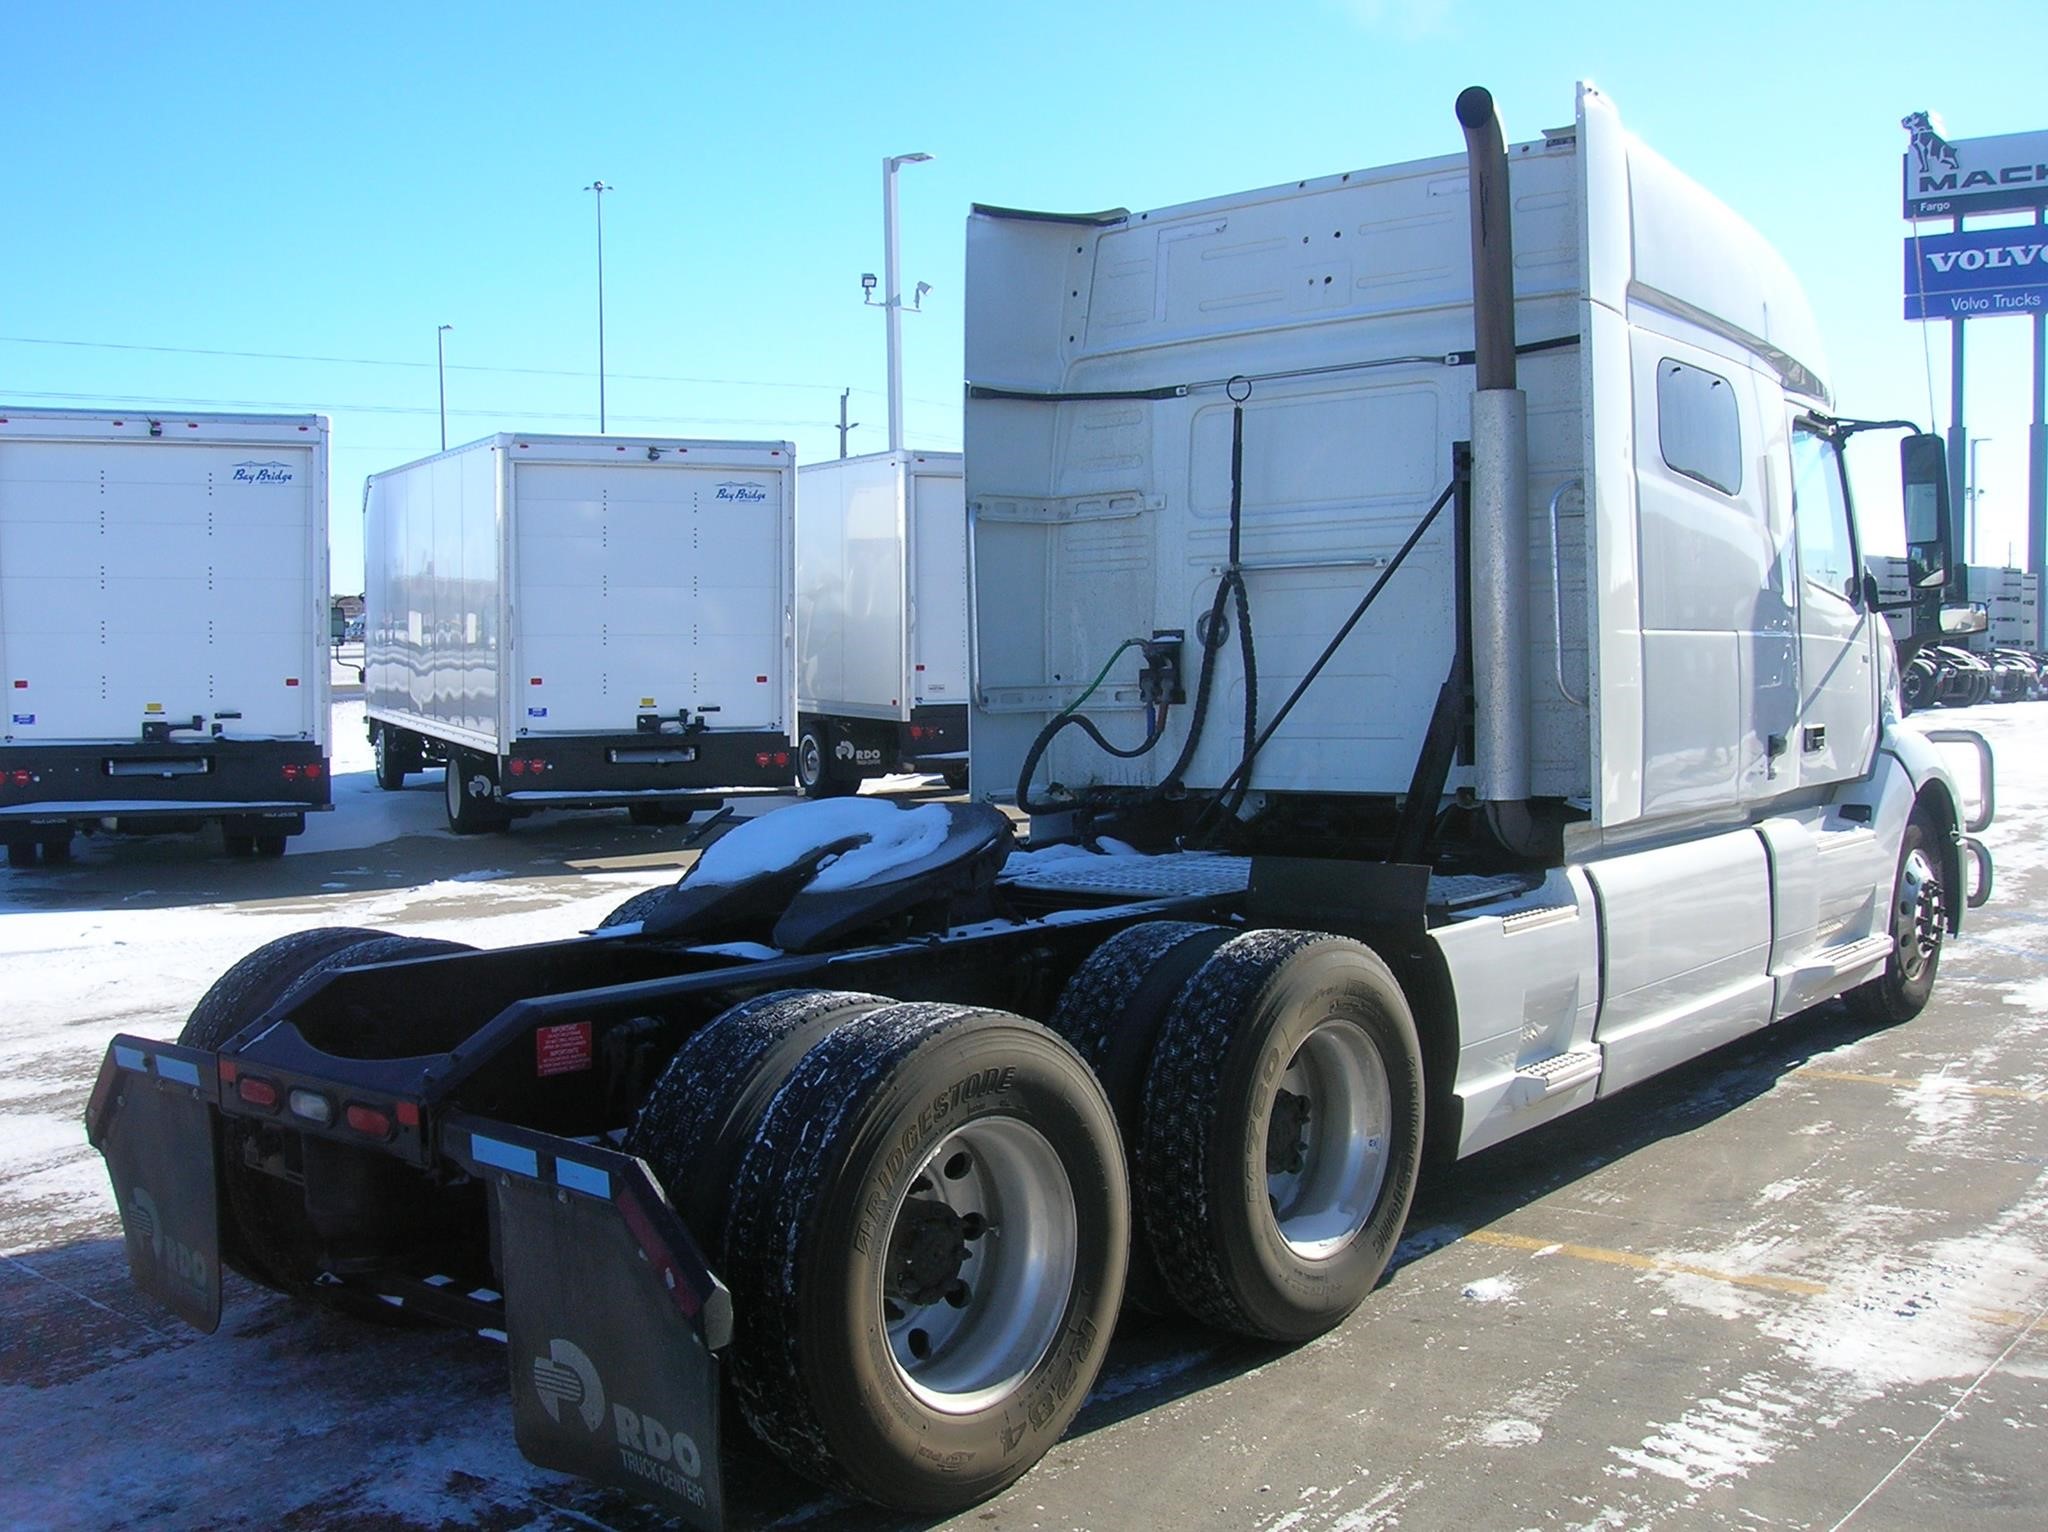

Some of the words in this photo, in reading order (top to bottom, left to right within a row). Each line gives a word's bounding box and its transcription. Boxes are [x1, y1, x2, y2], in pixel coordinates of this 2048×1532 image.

[1920, 201, 1950, 212] Fargo
[1951, 295, 1989, 311] Volvo
[1993, 292, 2041, 308] Trucks
[233, 468, 255, 484] Bay
[255, 468, 293, 484] Bridge
[715, 487, 735, 502] Bay
[735, 488, 766, 502] Bridge
[856, 749, 881, 760] RDO
[855, 1066, 1017, 1261] BRIDGESTONE
[164, 1235, 207, 1287] RDO
[1000, 1316, 1098, 1457] R284
[612, 1402, 702, 1478] RDO
[619, 1448, 660, 1484] TRUCK
[660, 1464, 706, 1510] CENTERS
